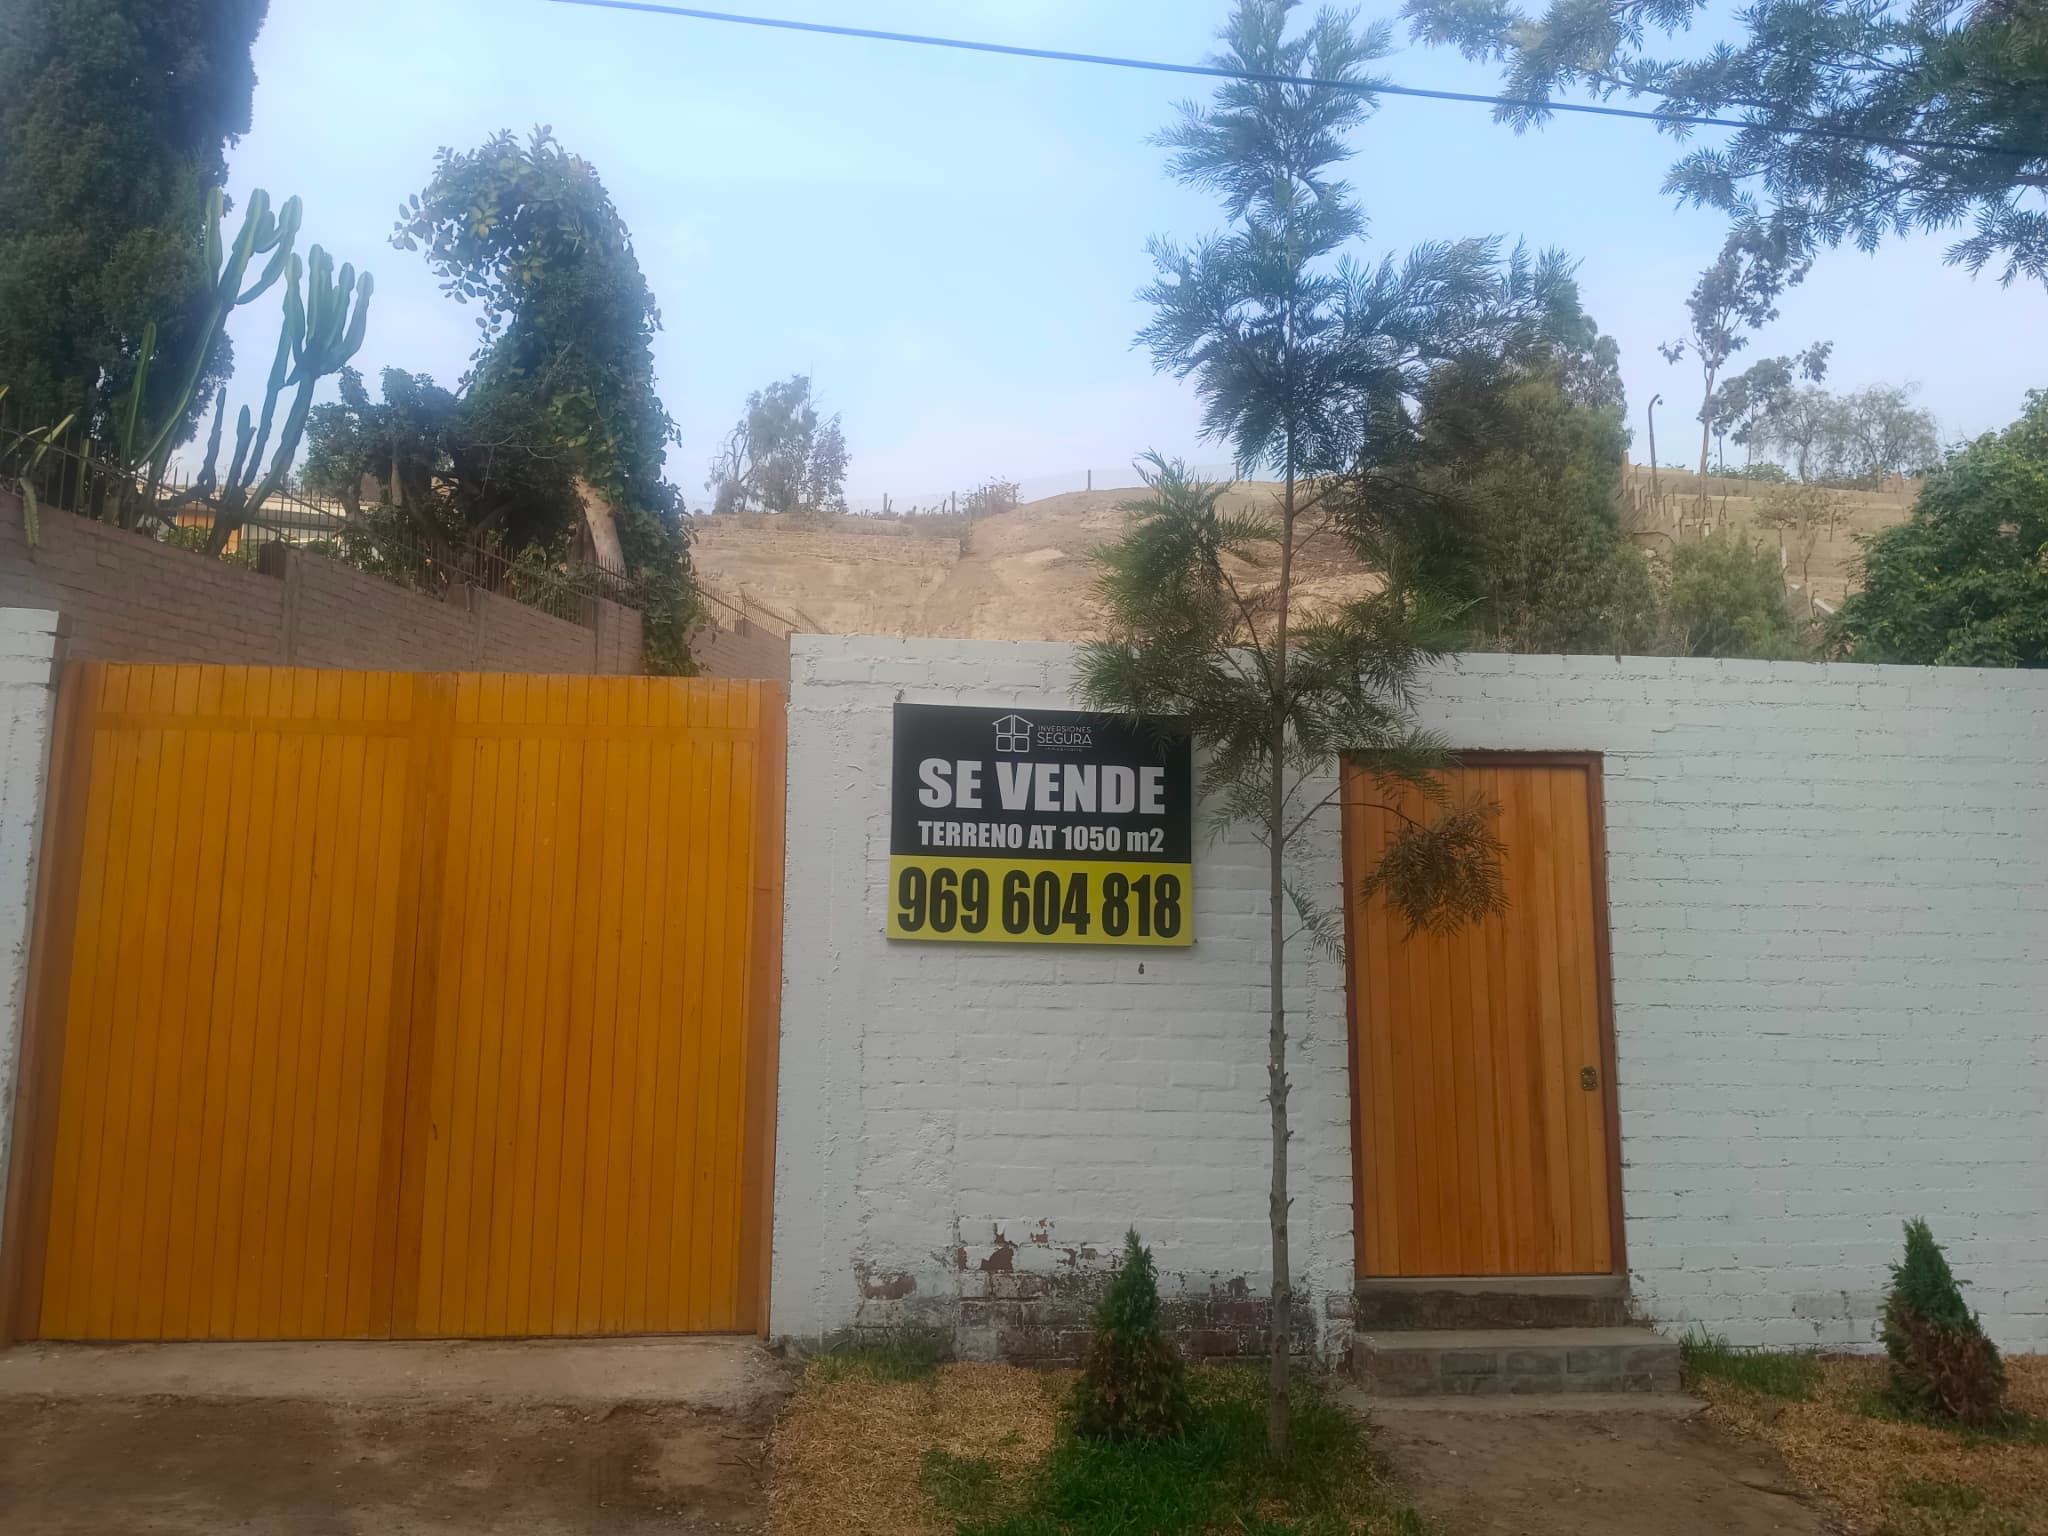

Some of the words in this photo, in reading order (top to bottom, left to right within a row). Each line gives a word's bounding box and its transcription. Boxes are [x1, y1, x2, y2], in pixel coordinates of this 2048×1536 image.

[1036, 732, 1093, 745] SEGURA
[1038, 725, 1092, 734] INVERSIONES
[918, 758, 982, 809] SE
[995, 761, 1165, 814] VENDE
[918, 820, 1022, 849] TERRENO
[1028, 824, 1057, 850] AT
[1061, 825, 1121, 851] 1050
[1126, 828, 1165, 852] m2
[897, 866, 990, 934] 969
[1001, 869, 1091, 936] 604
[1102, 872, 1182, 938] 818
